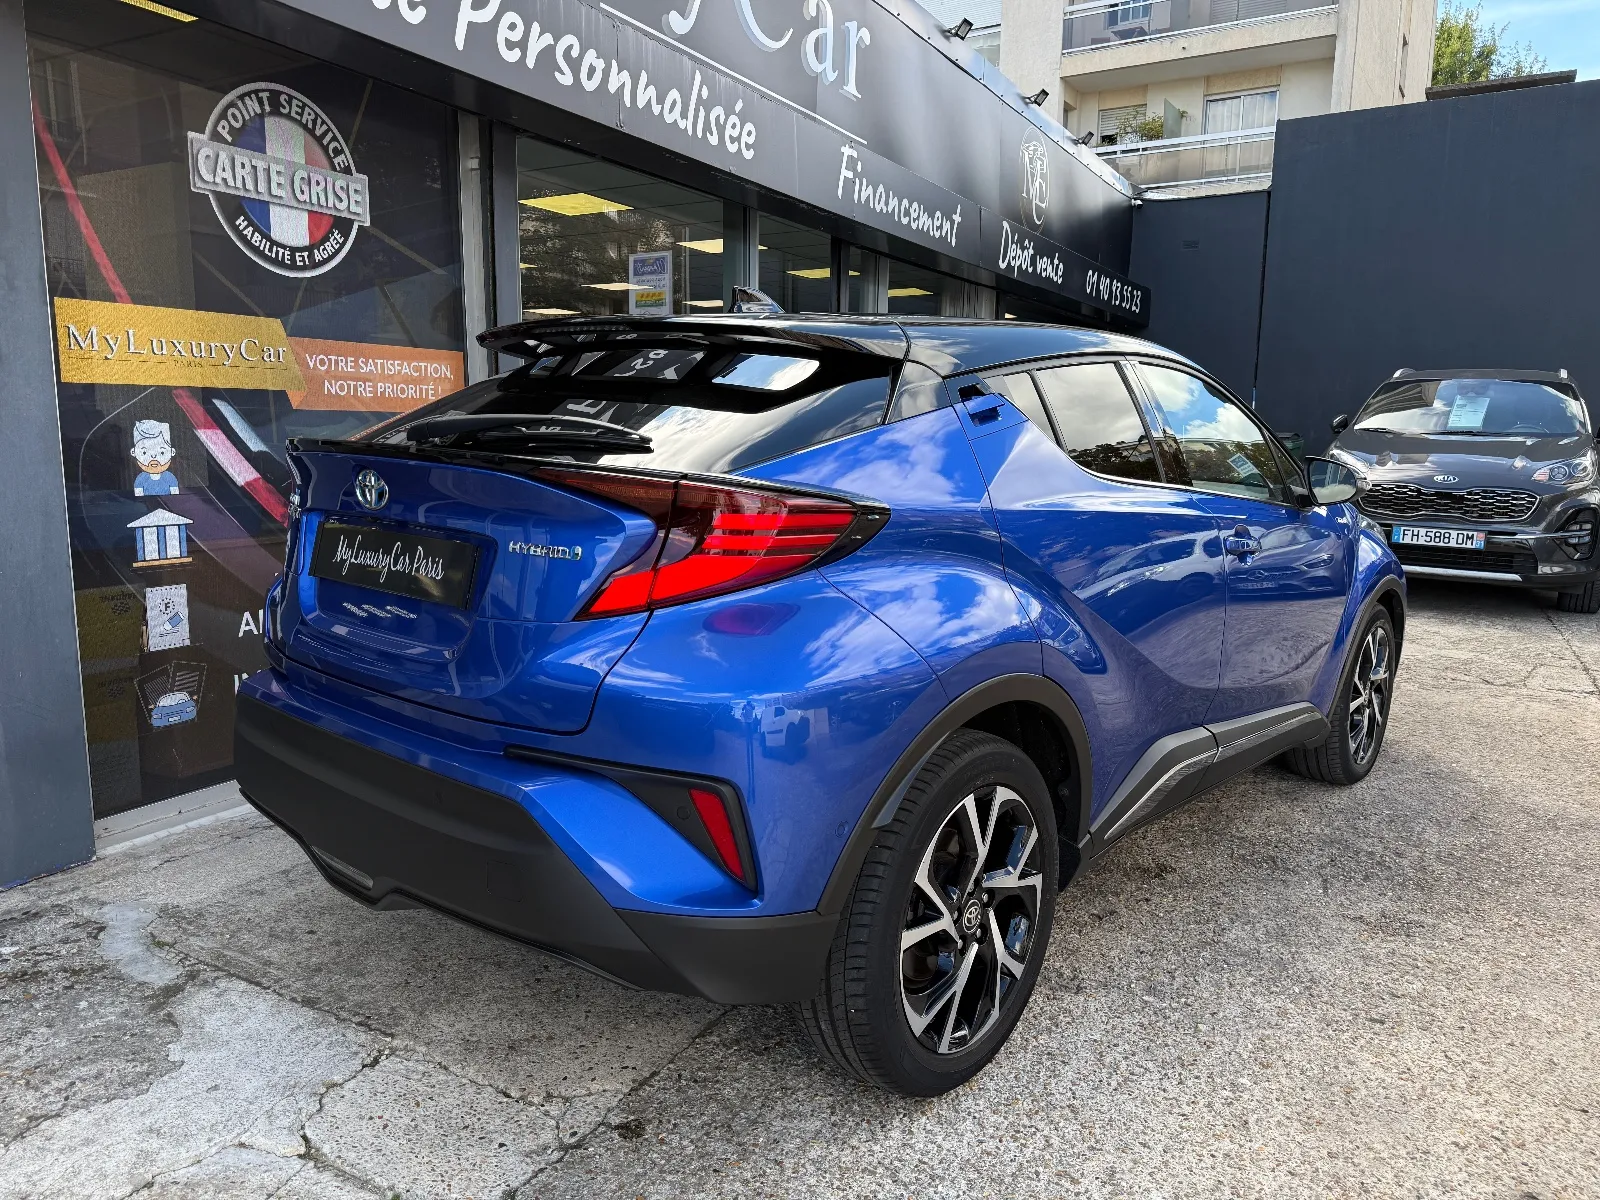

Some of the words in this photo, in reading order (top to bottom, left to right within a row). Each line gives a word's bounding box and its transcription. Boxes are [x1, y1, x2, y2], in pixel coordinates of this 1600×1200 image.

[455, 0, 757, 160] Personnalisée
[217, 91, 271, 142] POINT
[279, 94, 349, 171] SERVICE
[197, 147, 286, 197] CARTE
[293, 169, 363, 213] GRISE
[837, 144, 962, 247] Financement
[235, 215, 291, 264] HABILITÉ
[295, 251, 310, 266] ET
[314, 229, 345, 263] AGRÉÉ
[999, 220, 1034, 278] Dépôt
[1036, 253, 1064, 284] vente
[1086, 269, 1098, 297] 01
[1100, 274, 1110, 300] 40
[1111, 278, 1121, 305] 93
[1122, 285, 1132, 310] 55
[1132, 290, 1142, 313] 23
[64, 323, 287, 367] MyLuxuryCar
[306, 353, 355, 372] VOTRE
[358, 358, 454, 380] SATISFACTION,
[324, 379, 373, 397] NOTRE
[377, 381, 436, 400] PRIORITÉ
[1401, 528, 1475, 547] FH-588-DM
[411, 545, 445, 580] Paris
